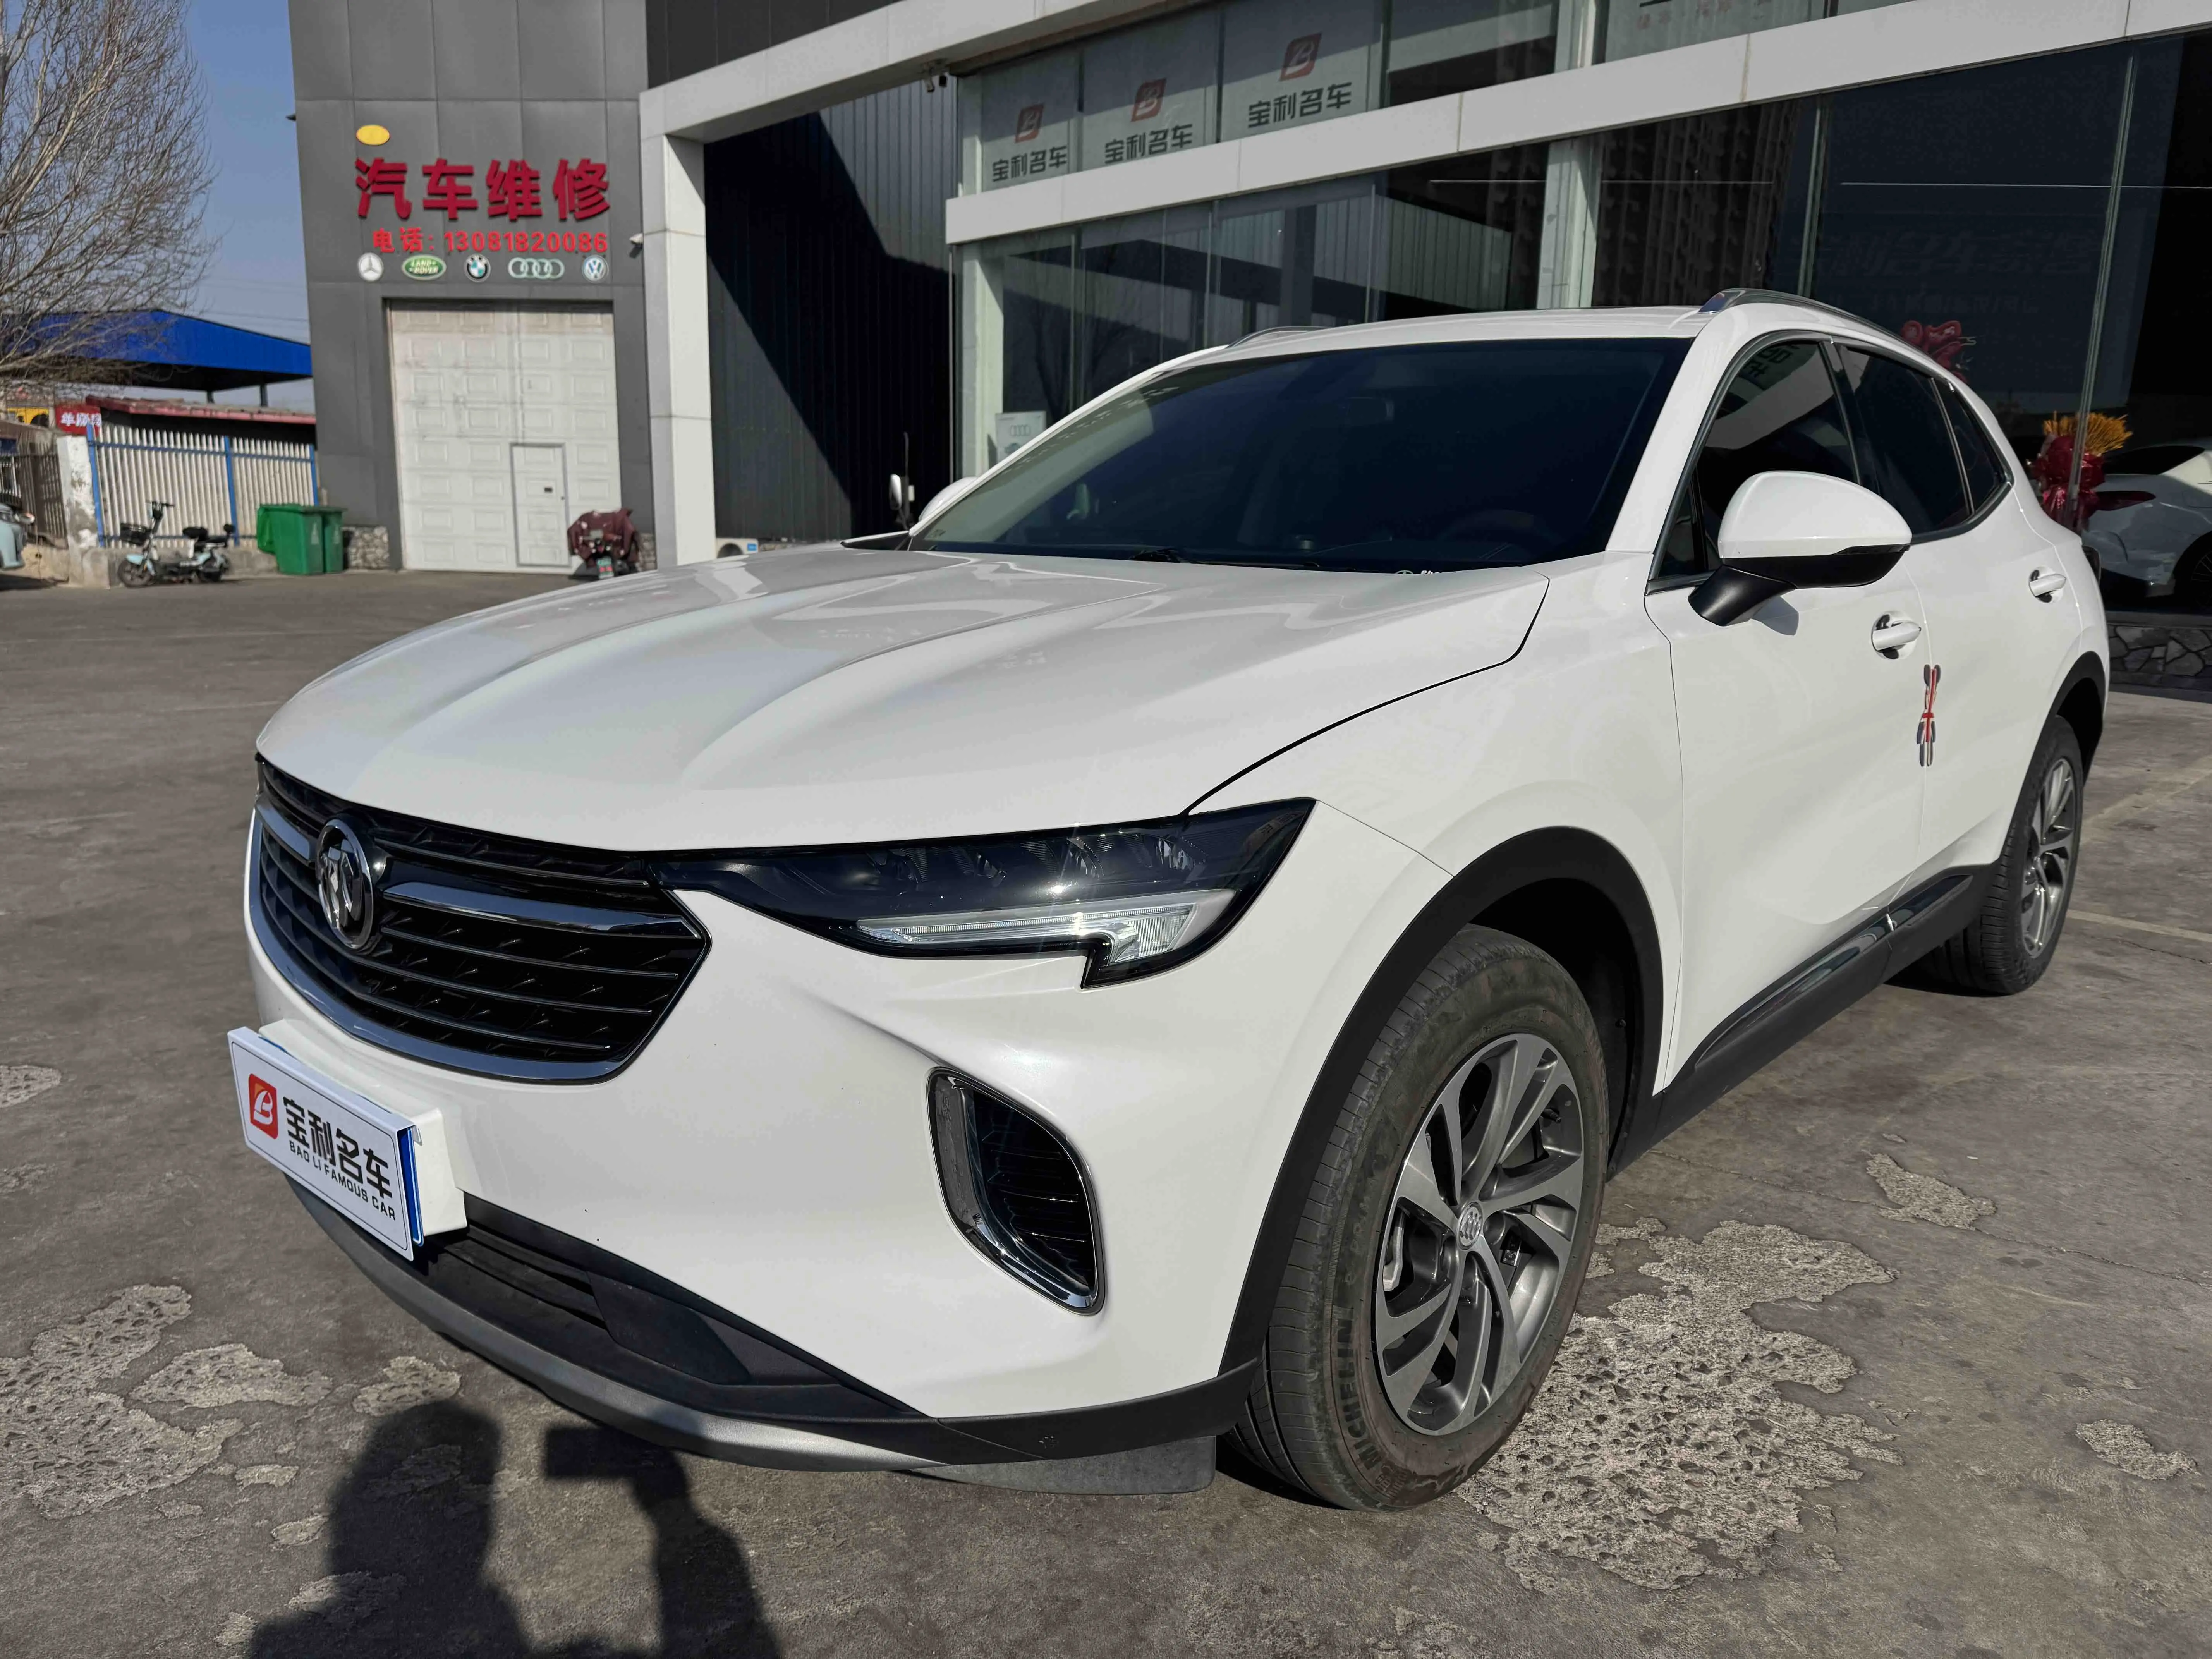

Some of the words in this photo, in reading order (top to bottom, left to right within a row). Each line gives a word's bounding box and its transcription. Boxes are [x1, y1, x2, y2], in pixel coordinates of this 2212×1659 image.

[1248, 82, 1352, 128] 宝利名车
[992, 144, 1067, 182] 宝利名车
[1105, 124, 1192, 165] 宝利名车
[355, 158, 610, 220] 汽车维修
[443, 231, 608, 253] 13081820086
[414, 266, 438, 275] ROVER
[283, 1096, 392, 1199] 宝利名车
[289, 1140, 310, 1163] BAO
[313, 1155, 321, 1171] LI
[324, 1164, 368, 1203] FAMOUS
[372, 1195, 395, 1220] CAR
[1337, 1318, 1383, 1470] MICHELIN
